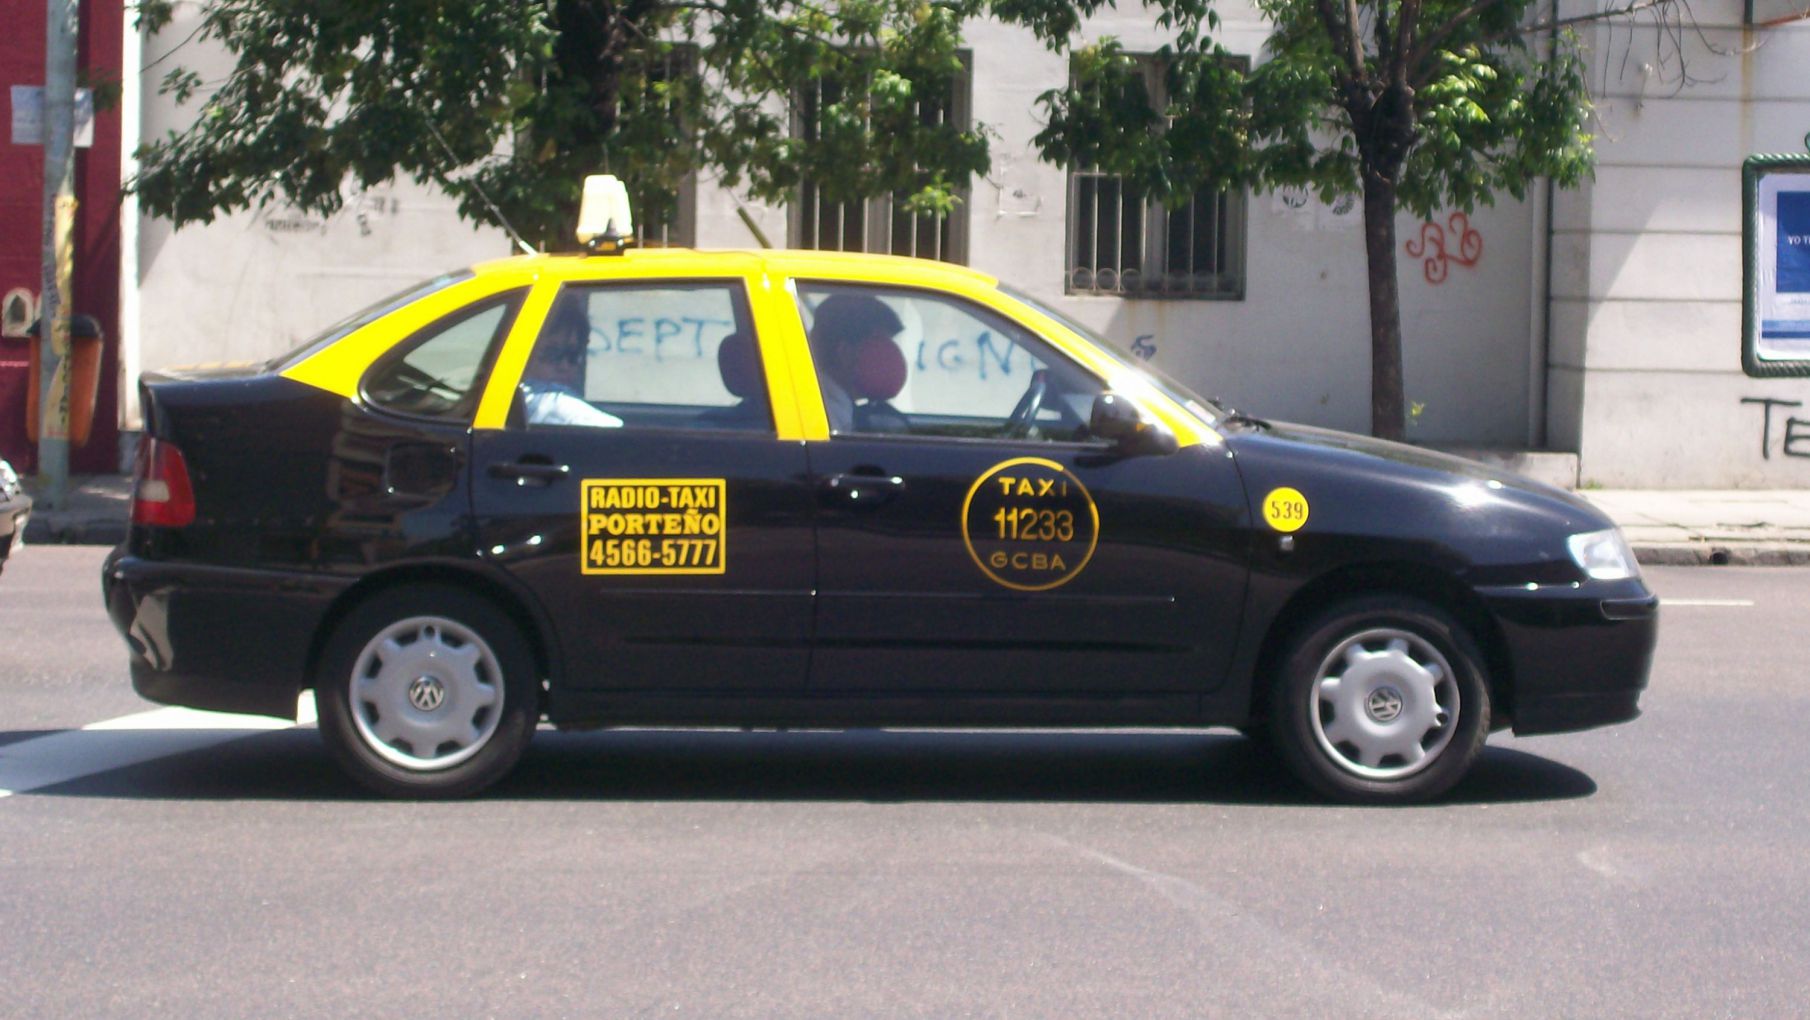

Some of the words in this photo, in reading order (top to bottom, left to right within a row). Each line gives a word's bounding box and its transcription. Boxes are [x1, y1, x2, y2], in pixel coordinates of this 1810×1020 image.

[590, 486, 716, 509] RADIO-TAXI
[998, 476, 1068, 497] TAXI
[588, 508, 720, 535] PORTEÑO
[1271, 500, 1303, 520] 539
[994, 506, 1074, 542] 11233
[589, 538, 717, 567] 4566-5777
[990, 551, 1067, 571] GCBA
